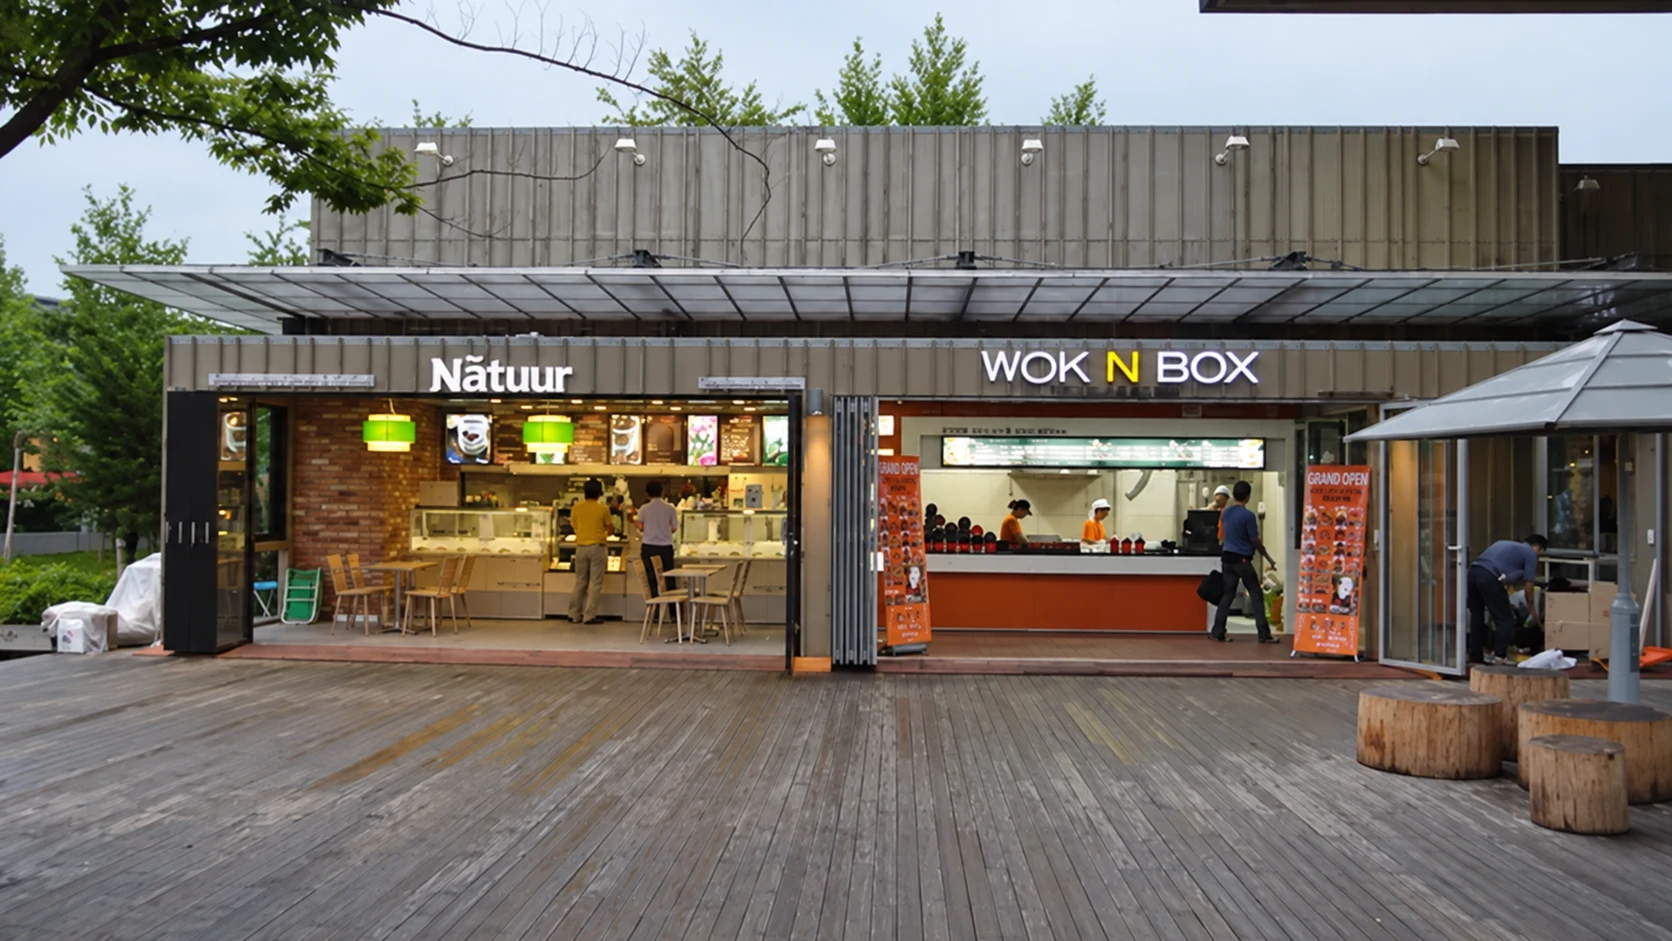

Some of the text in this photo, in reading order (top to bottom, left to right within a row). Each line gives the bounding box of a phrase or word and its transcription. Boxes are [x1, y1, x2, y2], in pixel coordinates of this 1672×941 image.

[981, 350, 1259, 384] WOK N BOX
[901, 462, 919, 476] OPEN
[1308, 471, 1369, 487] GRAND OPEN
